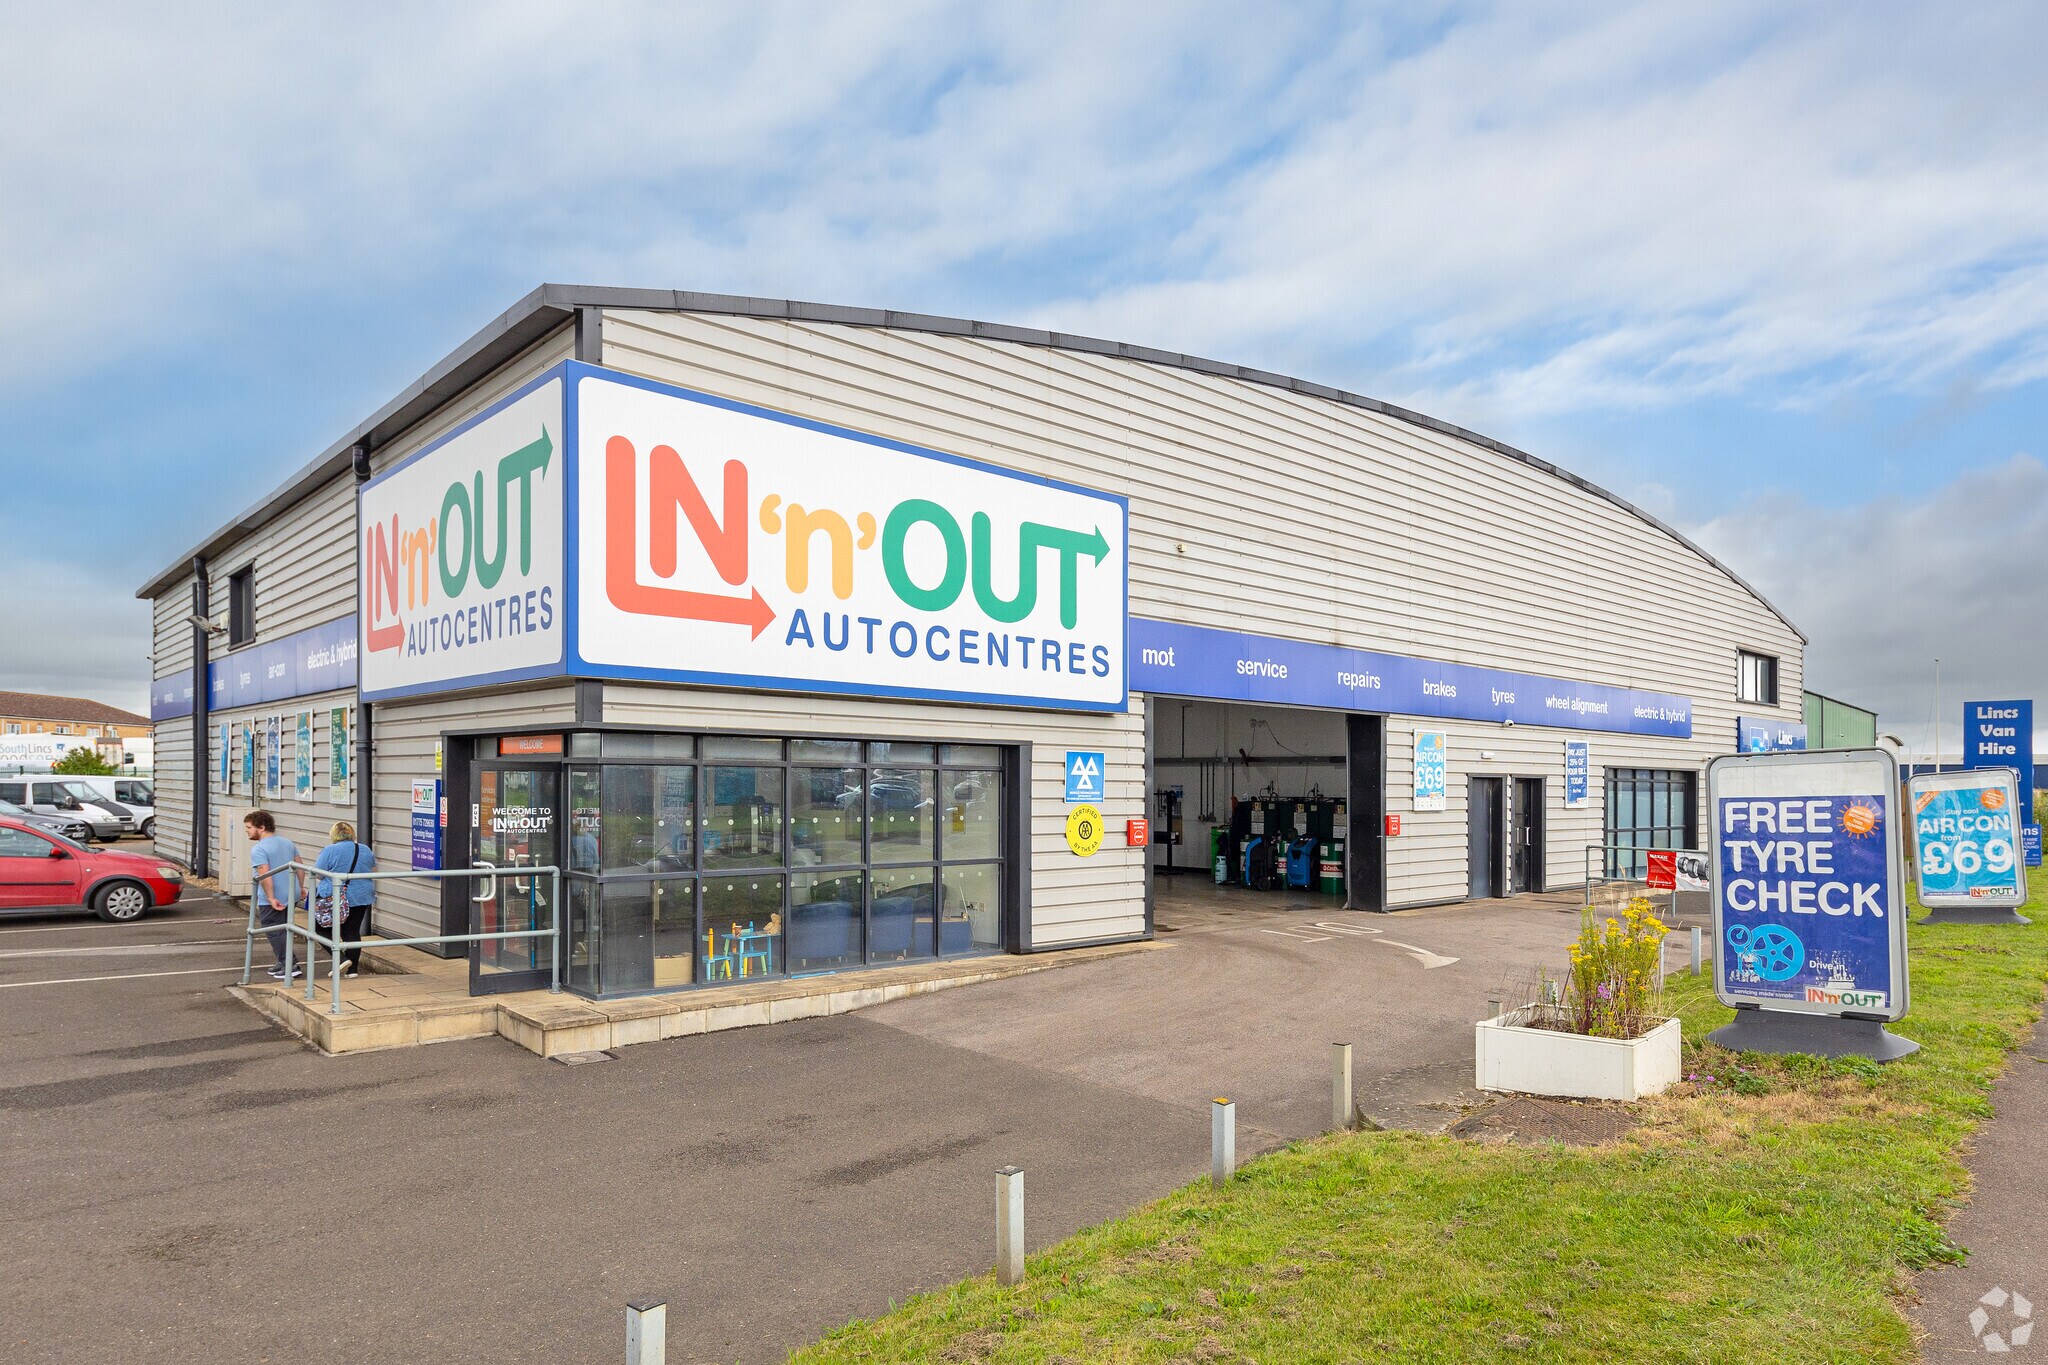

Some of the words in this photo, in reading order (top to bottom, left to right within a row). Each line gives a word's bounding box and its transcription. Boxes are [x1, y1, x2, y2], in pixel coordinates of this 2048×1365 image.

[407, 586, 553, 657] AUTOCENTRES
[785, 608, 1110, 677] AUTOCENTRES
[308, 648, 330, 669] electric
[331, 644, 335, 664] &
[336, 638, 357, 667] hybrid
[1142, 646, 1175, 667] mot
[1236, 658, 1288, 678] service
[1337, 670, 1381, 690] repairs
[1423, 679, 1457, 698] brakes
[1491, 687, 1515, 706] tyres
[1545, 696, 1570, 710] wheel
[1571, 698, 1608, 715] alignment
[1634, 704, 1659, 720] electric
[1659, 707, 1665, 720] &
[1666, 707, 1686, 725] hybrid
[1977, 706, 2019, 719] Lincs
[1778, 730, 1793, 745] Lincs
[1980, 724, 2016, 737] Van
[519, 739, 544, 750] WELCOME
[1979, 742, 2016, 755] Hire
[1428, 752, 1444, 763] CON
[1416, 766, 1443, 789] £69
[492, 807, 537, 816] WELCOME
[539, 807, 551, 815] TO
[1072, 808, 1098, 820] CERTIFIED
[1725, 800, 1833, 834] FREE
[1919, 817, 1956, 834] AIR
[1958, 814, 2010, 833] CON
[1724, 841, 1835, 874] TYRE
[1726, 879, 1884, 918] CHECK
[1809, 960, 1833, 971] Drive
[1734, 988, 1758, 997] servicing
[1758, 990, 1775, 998] made
